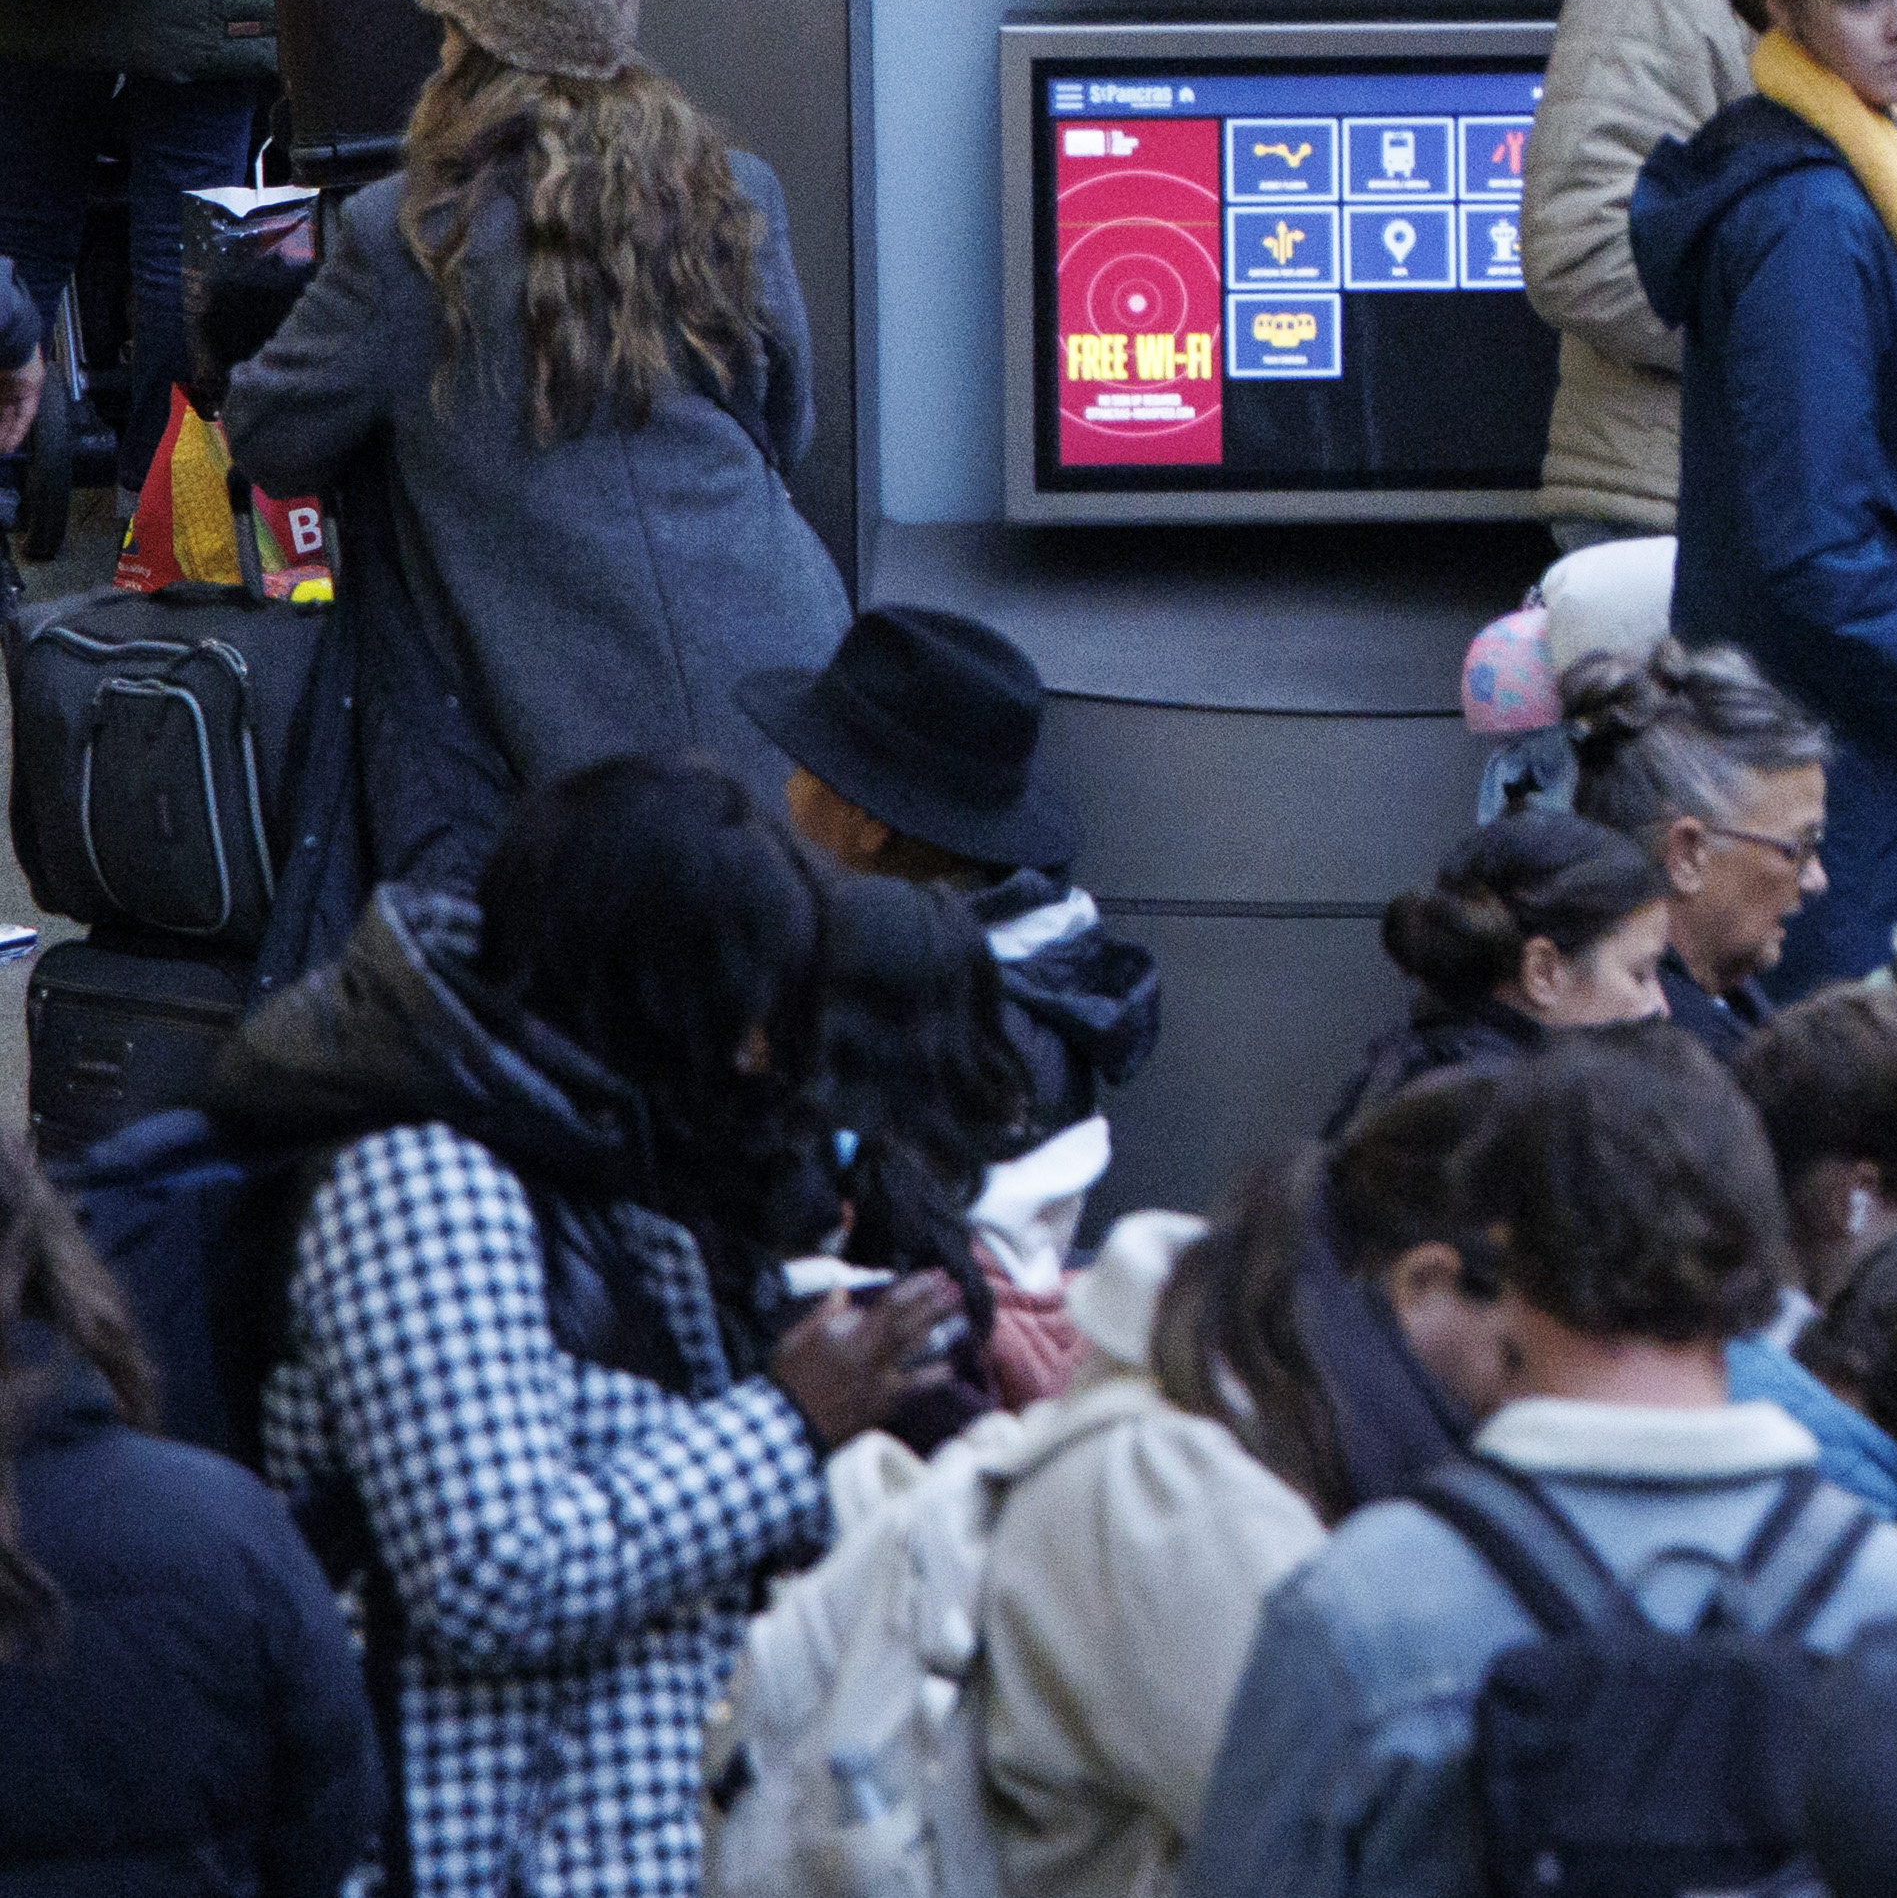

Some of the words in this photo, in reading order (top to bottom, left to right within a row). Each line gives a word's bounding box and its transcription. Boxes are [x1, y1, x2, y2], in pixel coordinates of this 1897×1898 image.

[1067, 333, 1129, 381] FREE
[1135, 332, 1212, 380] WI-FI
[288, 506, 323, 554] B
